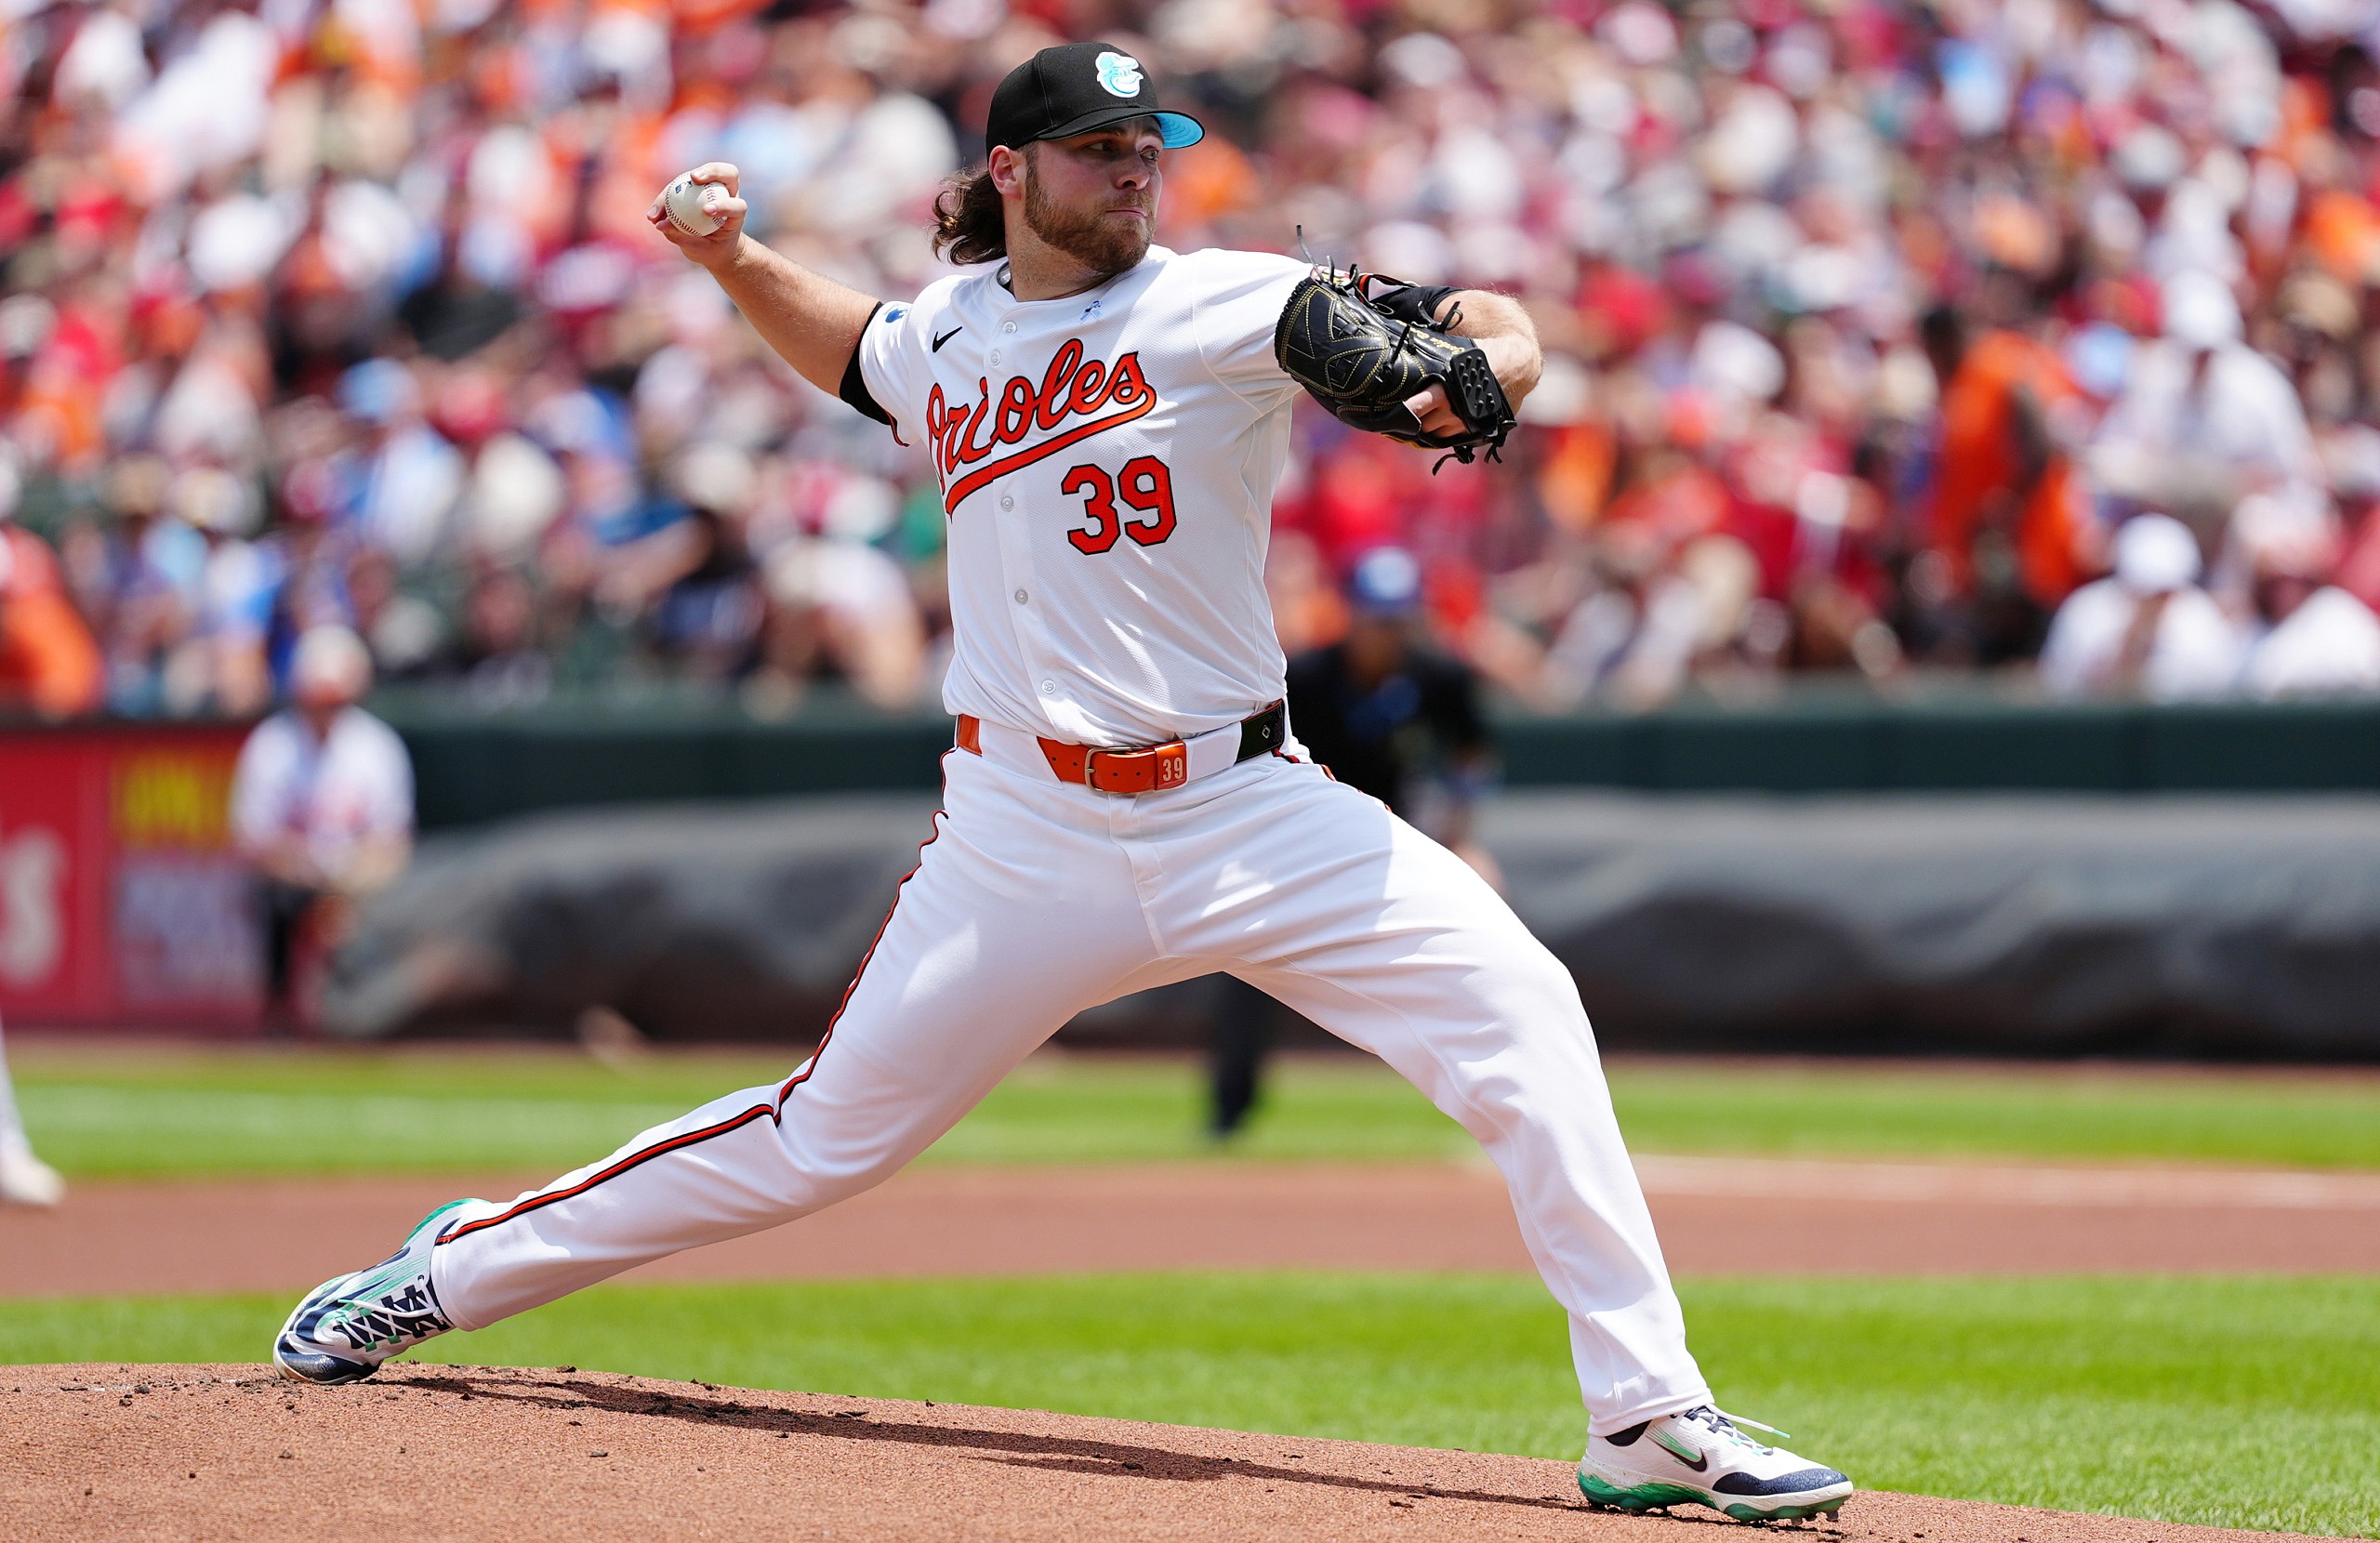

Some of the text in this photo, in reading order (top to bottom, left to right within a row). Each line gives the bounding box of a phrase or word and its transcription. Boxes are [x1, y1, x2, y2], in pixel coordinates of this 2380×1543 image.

[926, 337, 1157, 517] Orioles
[1061, 455, 1177, 556] 39
[1162, 757, 1183, 782] 39
